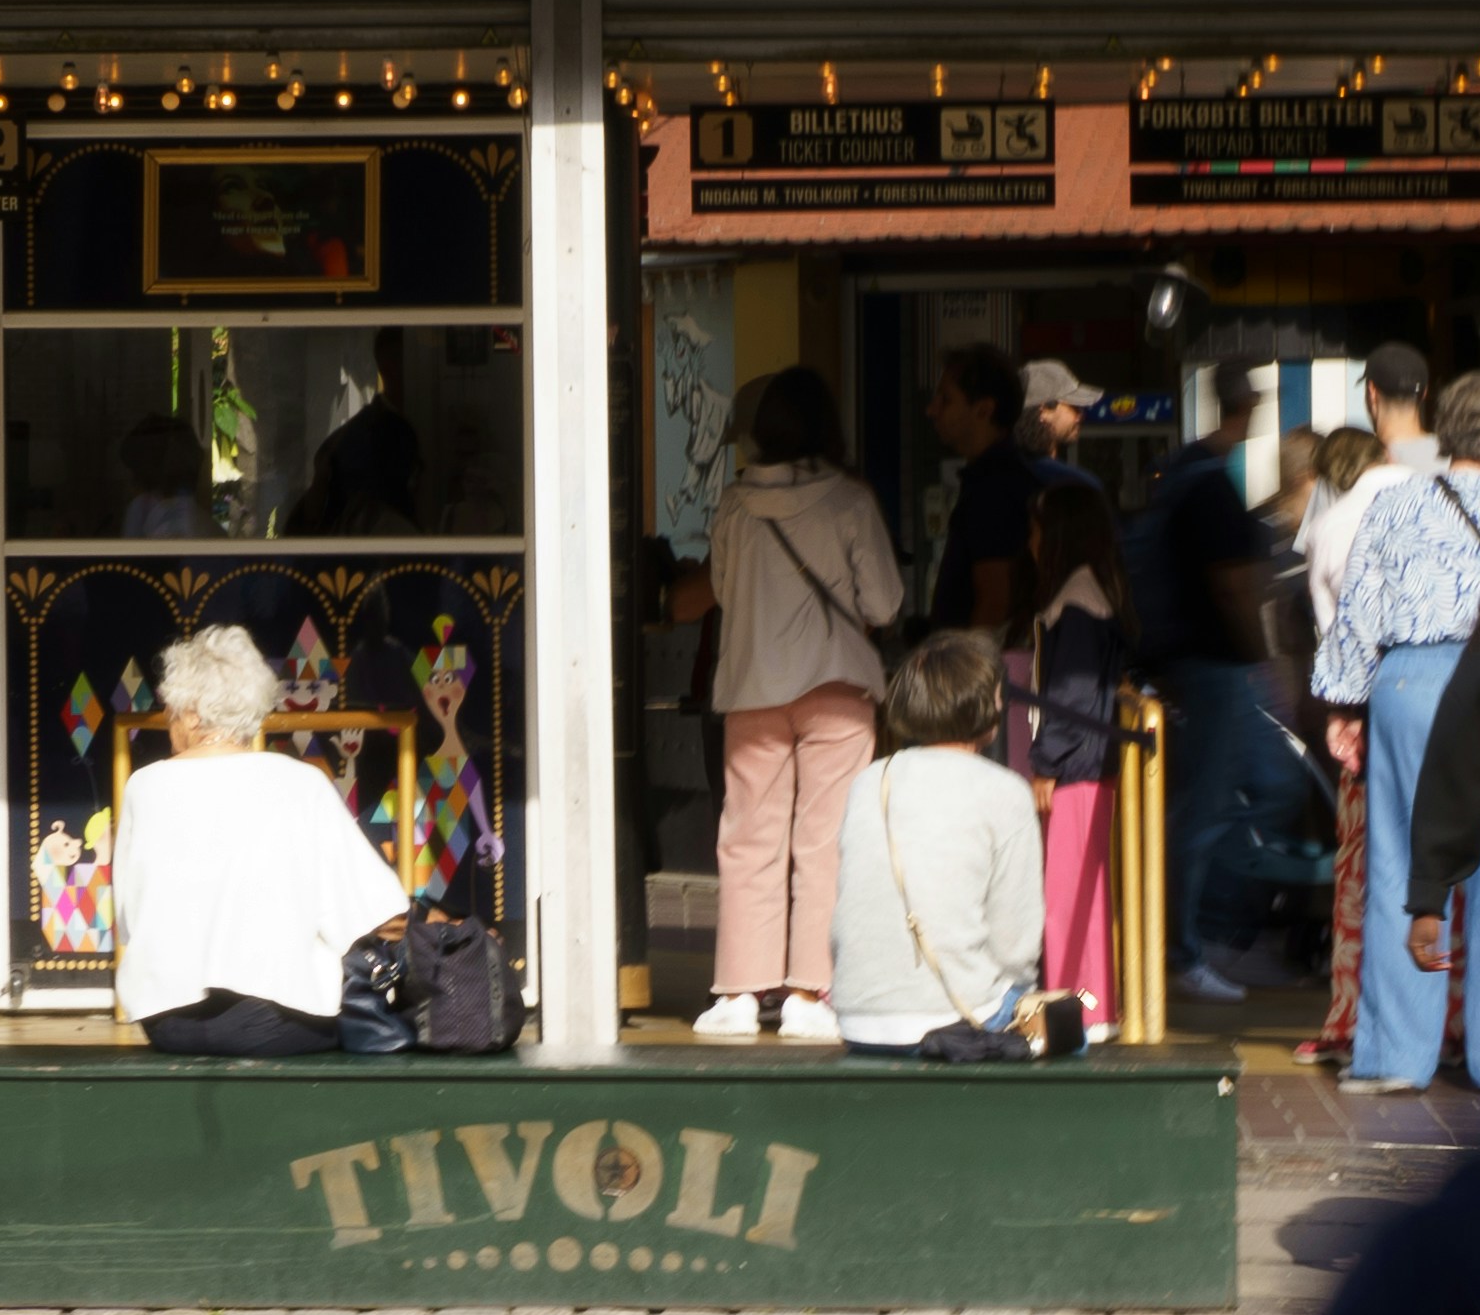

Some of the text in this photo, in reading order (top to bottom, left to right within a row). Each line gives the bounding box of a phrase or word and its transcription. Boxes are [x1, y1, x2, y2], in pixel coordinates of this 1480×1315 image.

[790, 107, 903, 134] BILLETHUS
[1259, 98, 1373, 128] BILLETTER
[713, 117, 734, 159] 1
[778, 136, 915, 164] TICKET COUNTER
[1184, 128, 1327, 157] PREPAID TICKETS
[699, 187, 758, 206] INDGANG
[763, 186, 780, 205] M.
[785, 185, 859, 204] TIVOLIKORT
[1182, 178, 1258, 200] TIVOLIKORT
[291, 1119, 821, 1250] TIVOLI
